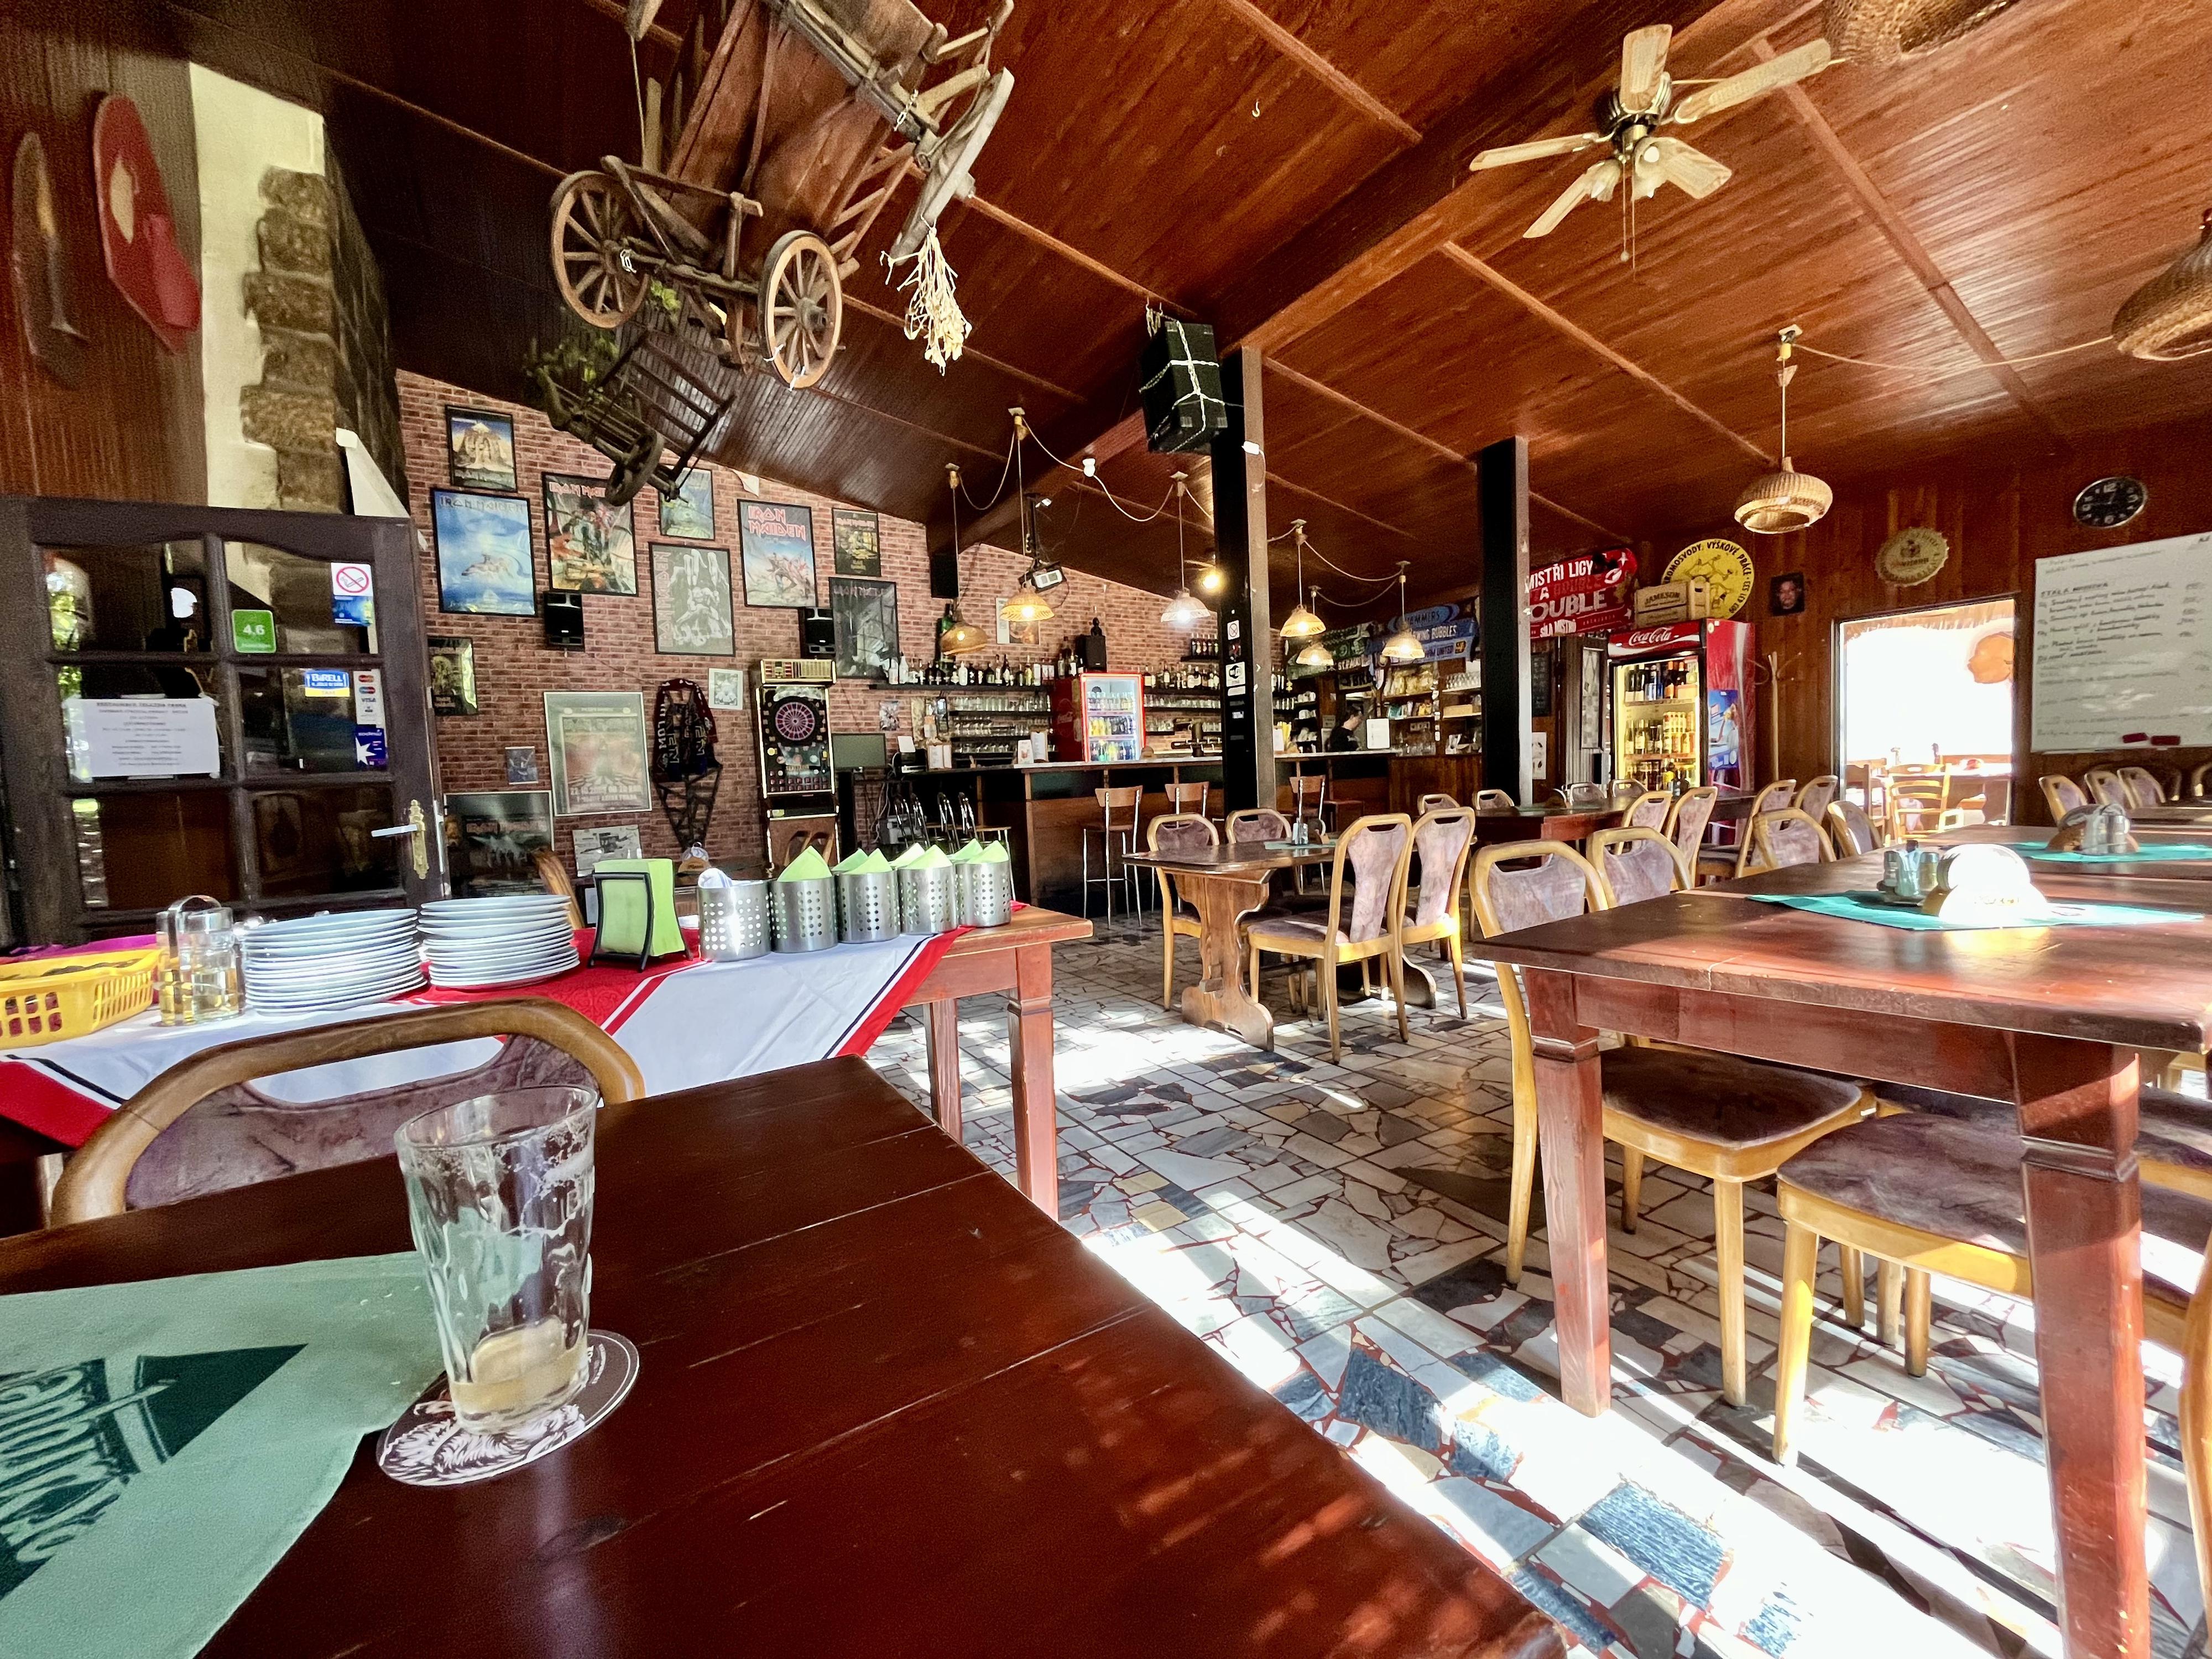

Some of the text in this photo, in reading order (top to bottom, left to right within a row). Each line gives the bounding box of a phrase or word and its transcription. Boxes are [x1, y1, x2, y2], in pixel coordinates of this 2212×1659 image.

[748, 505, 786, 525] IRON
[748, 520, 806, 542] MAIDEN
[1568, 560, 1593, 578] LIGY
[1664, 544, 1703, 583] ROMOSVODY,
[1530, 588, 1607, 623] OUBLE
[1644, 592, 1681, 605] JAMESON
[242, 624, 265, 636] 4.6
